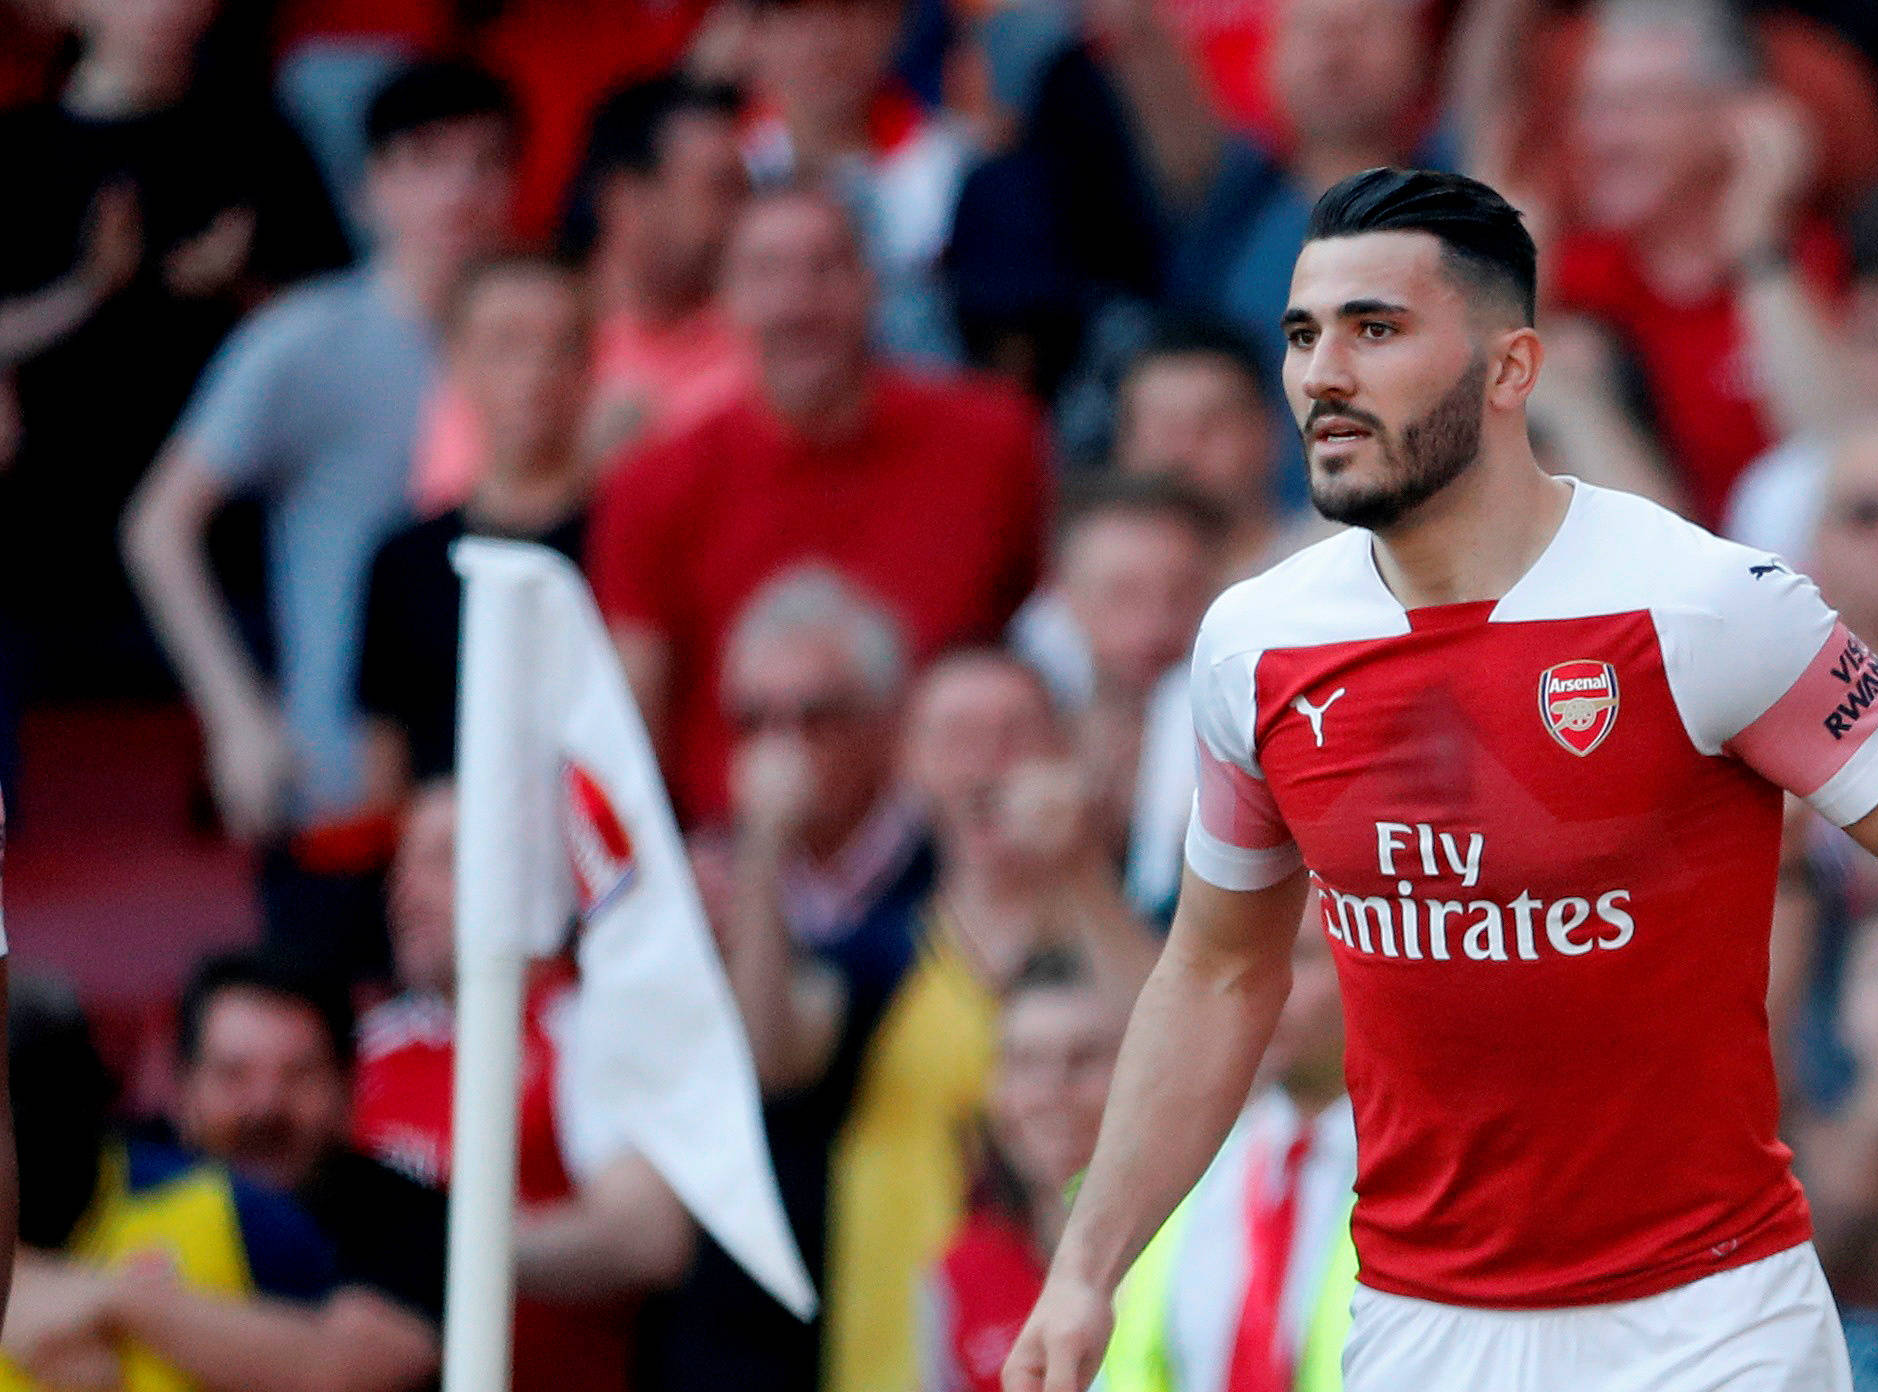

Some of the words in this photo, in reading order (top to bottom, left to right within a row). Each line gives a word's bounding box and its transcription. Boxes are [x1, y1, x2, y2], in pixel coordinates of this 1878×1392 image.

[1549, 673, 1608, 693] Arsenal
[1830, 639, 1865, 683] VIS
[1375, 821, 1484, 887] Fly
